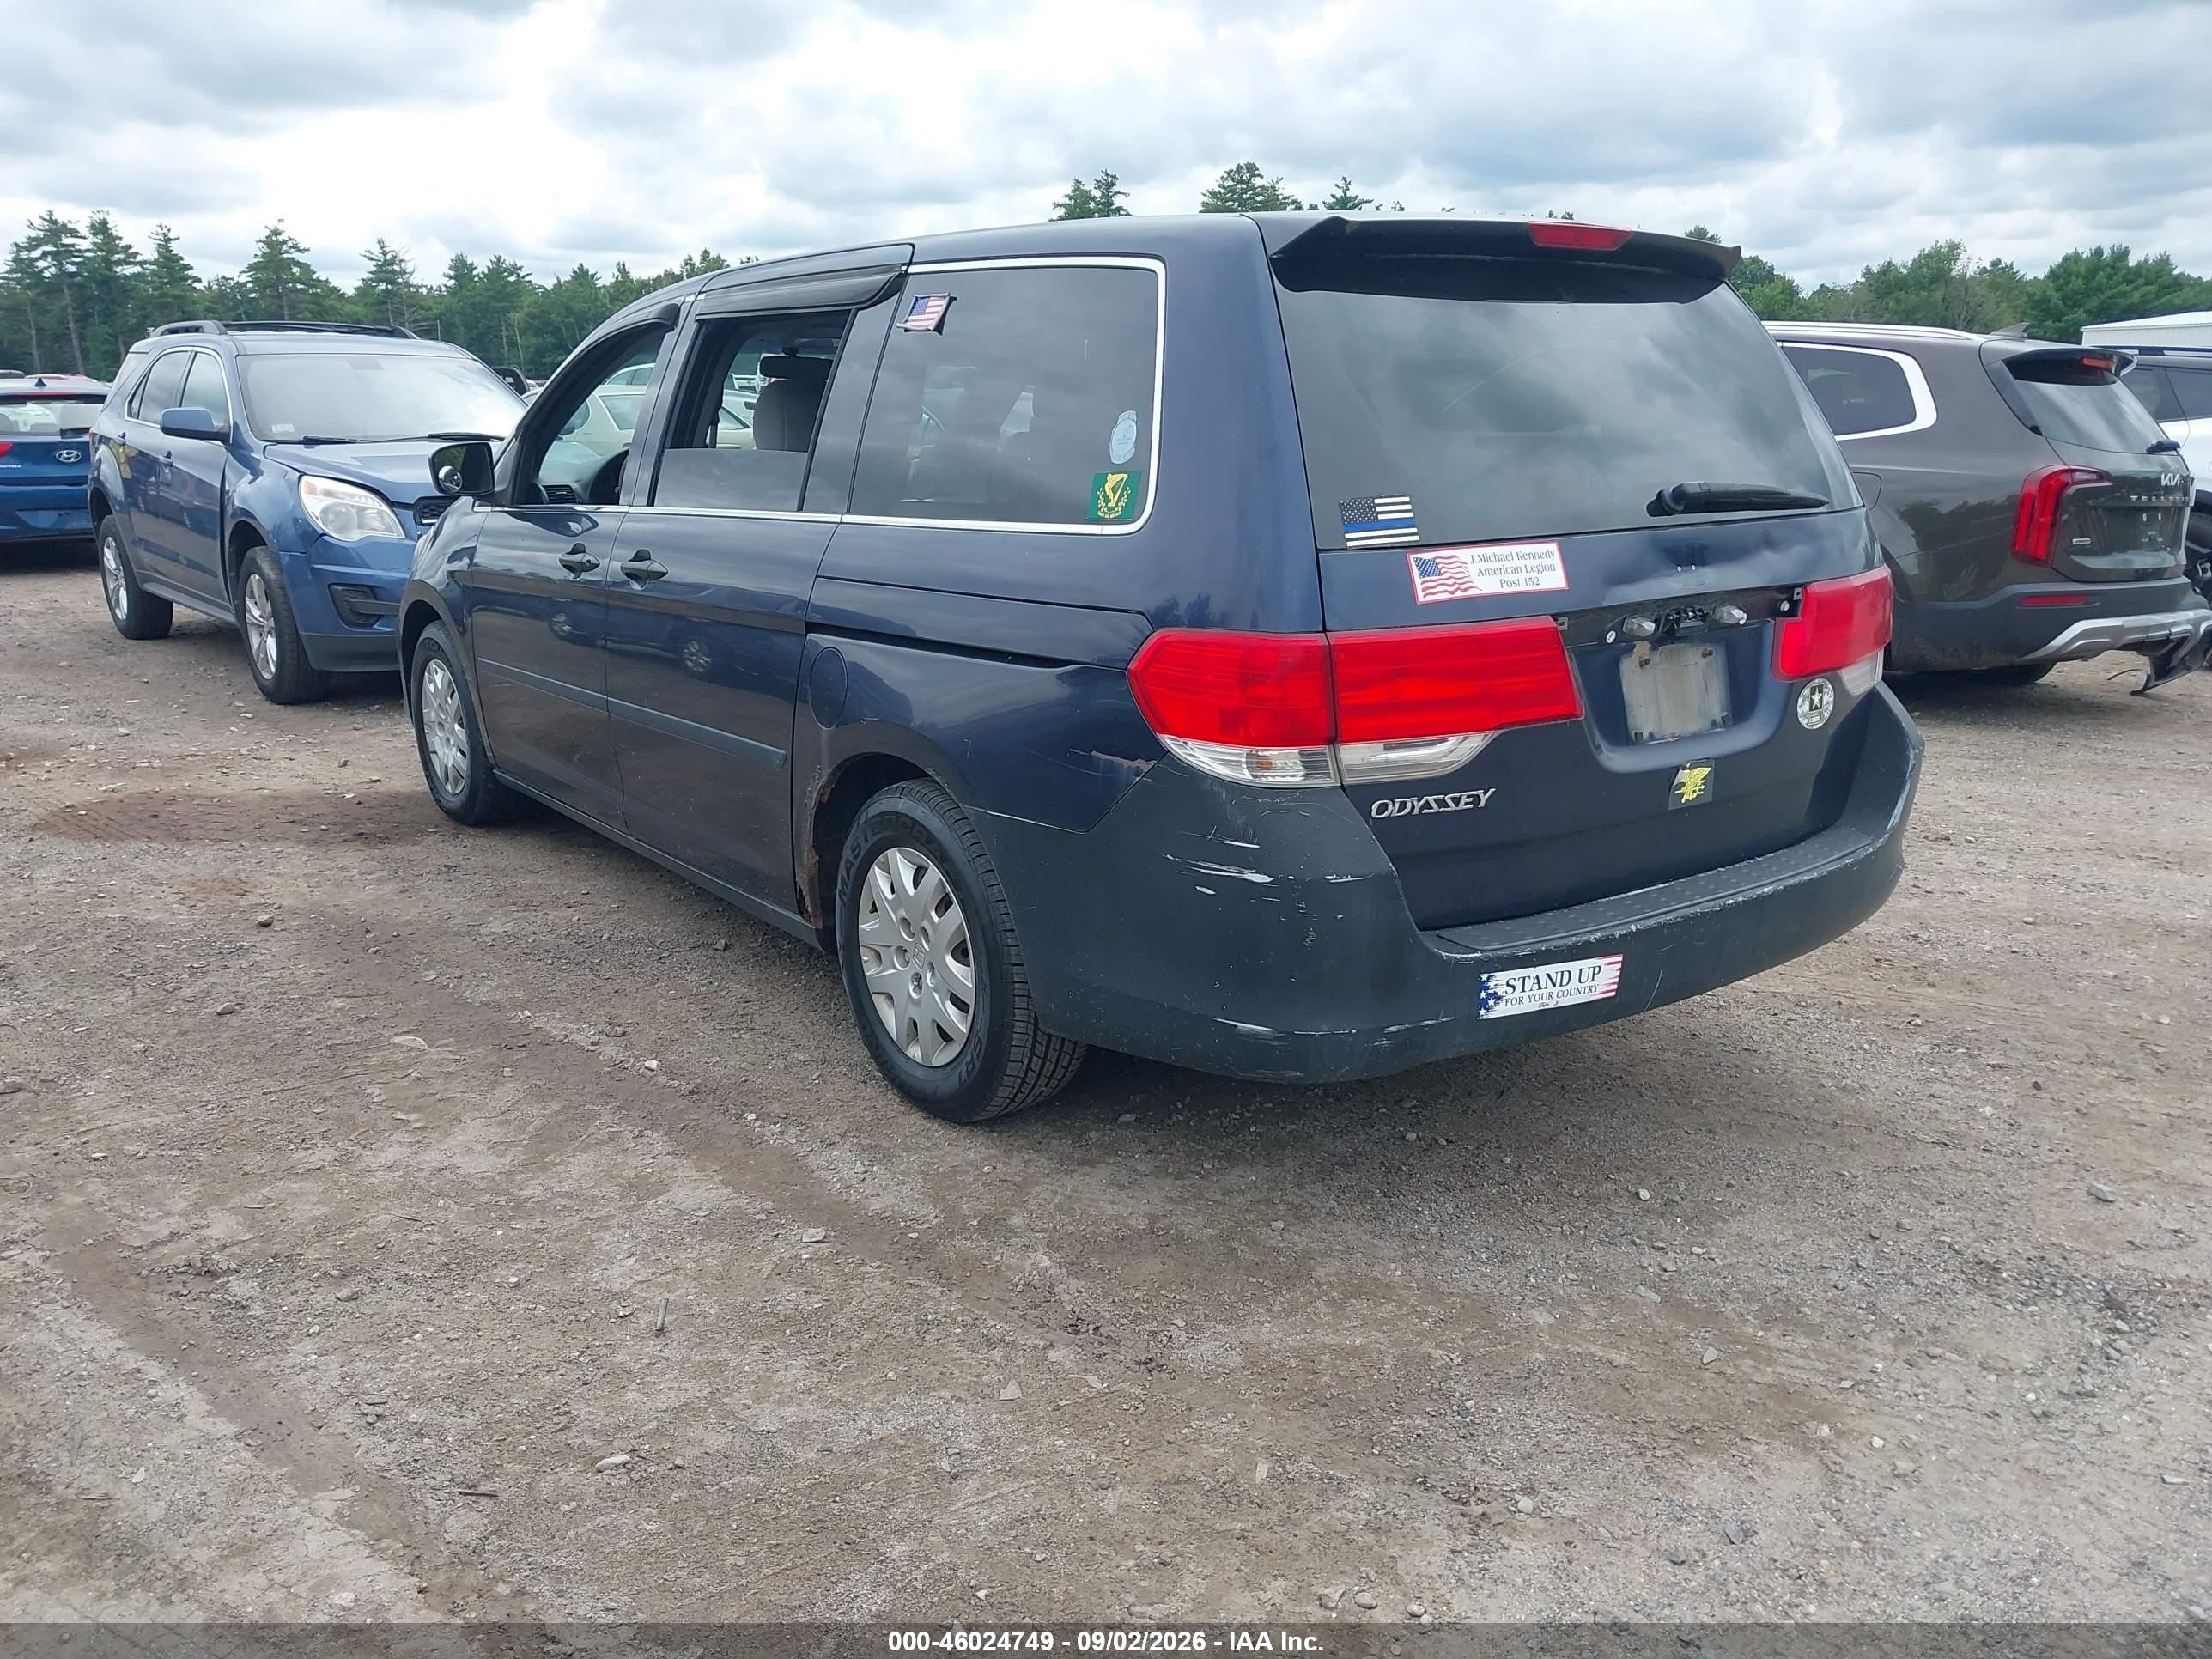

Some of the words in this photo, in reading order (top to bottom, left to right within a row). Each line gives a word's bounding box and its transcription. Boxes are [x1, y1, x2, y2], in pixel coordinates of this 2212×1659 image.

[1516, 549, 1556, 562] Kennedy
[1477, 562, 1523, 577] American
[1524, 562, 1557, 576] Legion
[1499, 578, 1521, 589] Post
[1523, 576, 1540, 587] 152
[1371, 788, 1497, 819] ODYSSEY
[1504, 969, 1571, 995] STAND
[1577, 965, 1602, 984] UP
[1504, 997, 1524, 1007] FOR
[1526, 991, 1554, 1004] YOUR
[1556, 983, 1600, 999] COUNTRY
